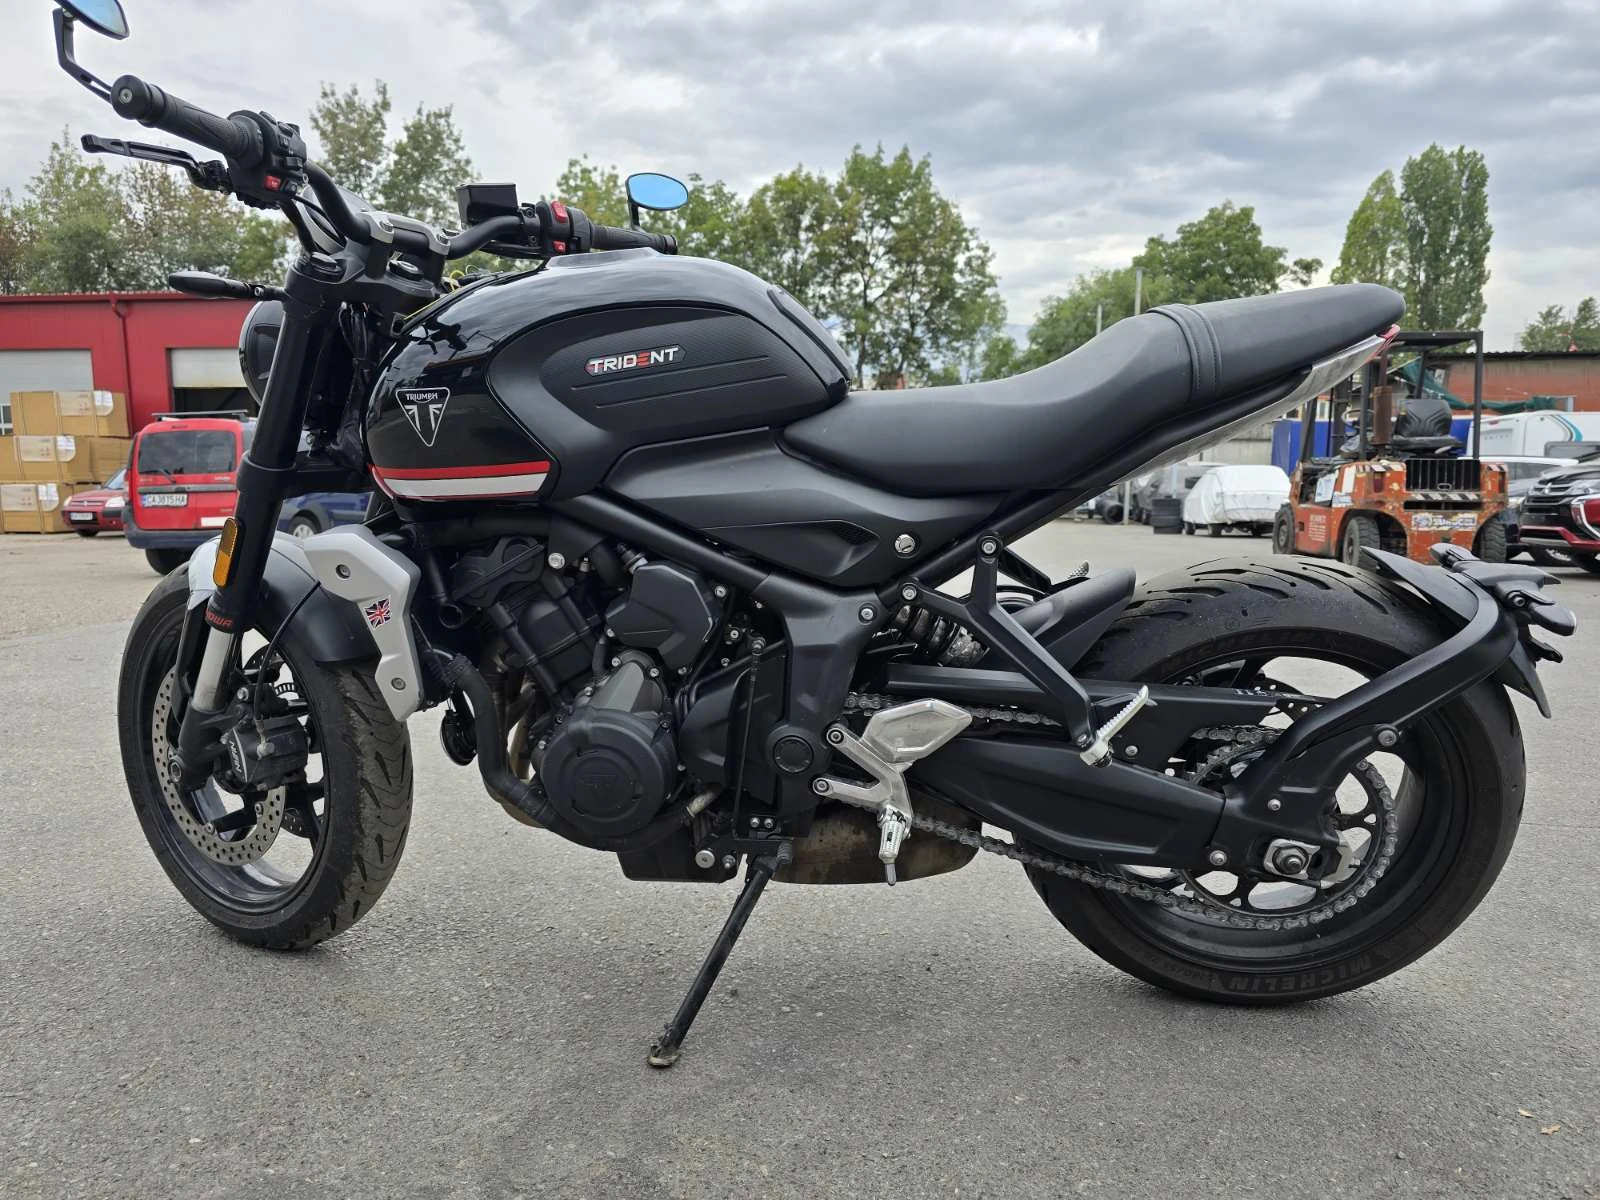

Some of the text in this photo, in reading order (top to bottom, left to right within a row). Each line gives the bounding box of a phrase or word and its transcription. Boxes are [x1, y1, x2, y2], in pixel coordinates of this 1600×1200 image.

[589, 347, 679, 373] TRIDENT
[405, 392, 438, 402] TRIUMPH
[1227, 951, 1372, 992] MICHELIN
